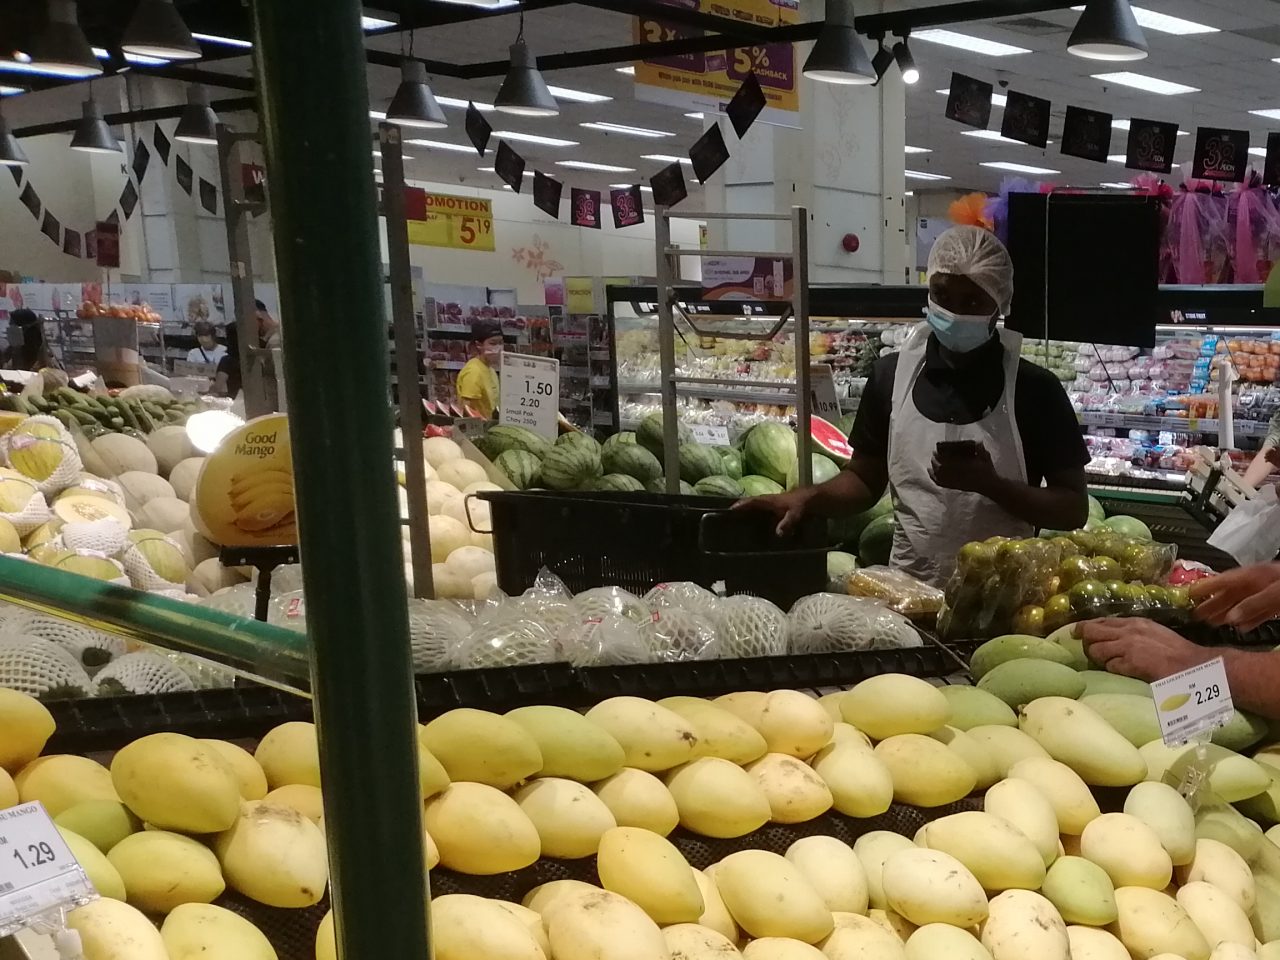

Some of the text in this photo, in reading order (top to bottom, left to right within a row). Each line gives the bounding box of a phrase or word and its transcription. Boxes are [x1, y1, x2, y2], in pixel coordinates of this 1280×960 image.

[424, 196, 489, 213] OMOTION
[525, 380, 553, 396] 1.50
[520, 397, 540, 408] 2.20
[245, 431, 277, 444] Good
[234, 443, 275, 459] Mango
[1195, 684, 1220, 705] 2.29
[8, 805, 38, 817] MANGO
[13, 841, 56, 869] 1.29
